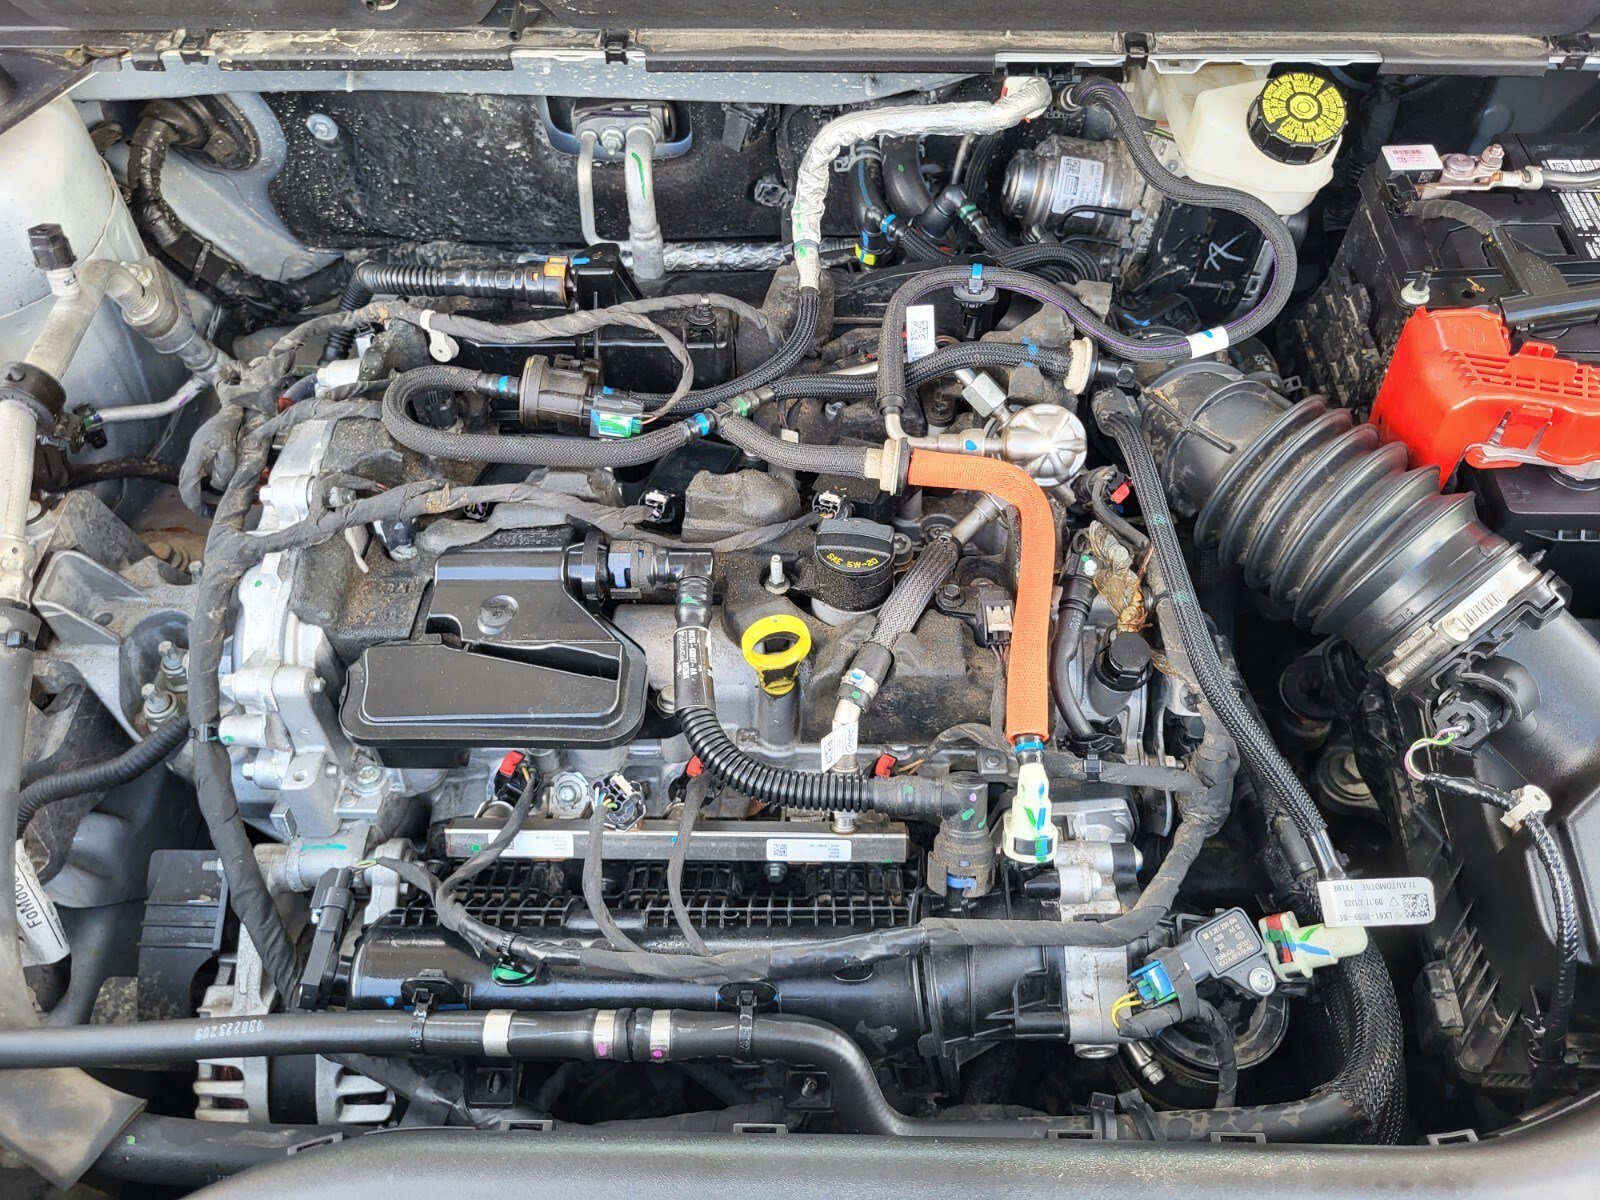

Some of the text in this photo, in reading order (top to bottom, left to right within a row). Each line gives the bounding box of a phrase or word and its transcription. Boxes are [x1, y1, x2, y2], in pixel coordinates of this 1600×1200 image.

[826, 553, 879, 569] SAE 5W-20
[1361, 881, 1407, 891] AUTOMOTIVE
